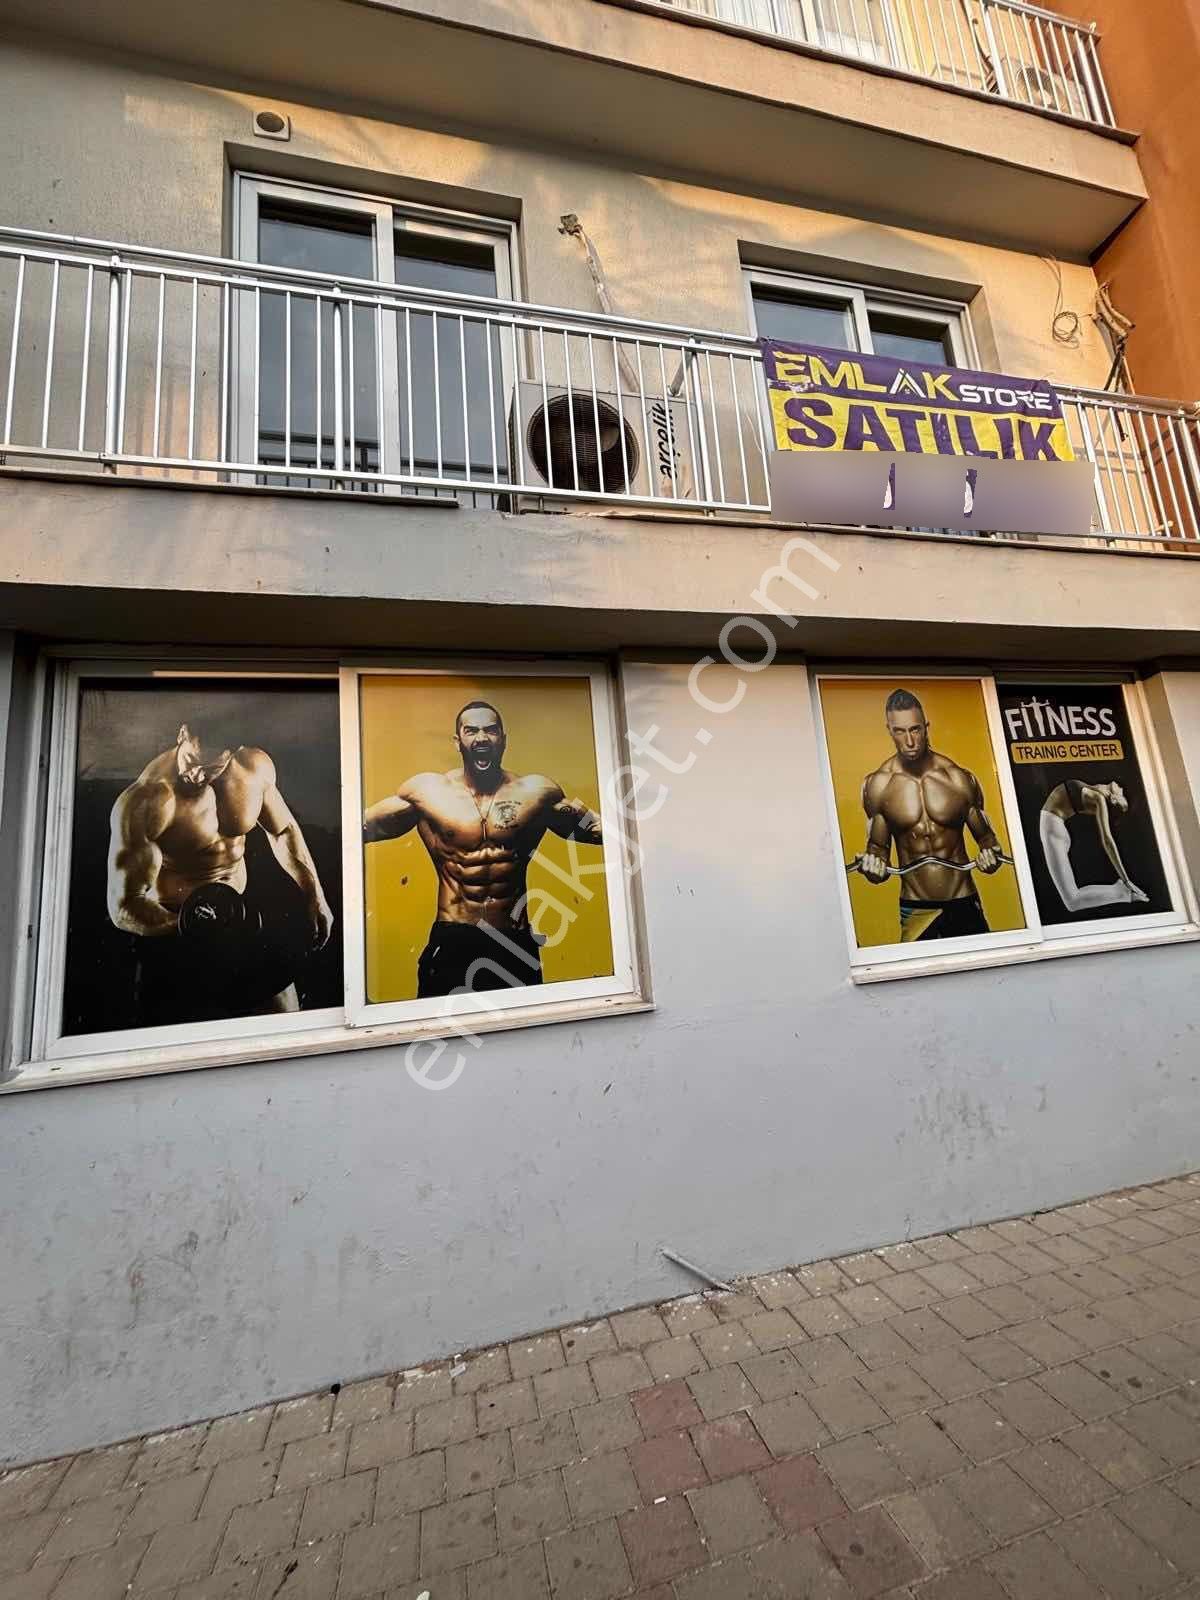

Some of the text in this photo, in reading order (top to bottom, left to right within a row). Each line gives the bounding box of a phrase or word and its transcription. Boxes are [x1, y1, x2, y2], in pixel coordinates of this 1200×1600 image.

[772, 351, 1053, 411] EMLAK STORE
[783, 398, 1061, 462] SATILIK
[1004, 696, 1117, 740] FITNESS
[1016, 744, 1119, 762] TRAINIG CENTER
